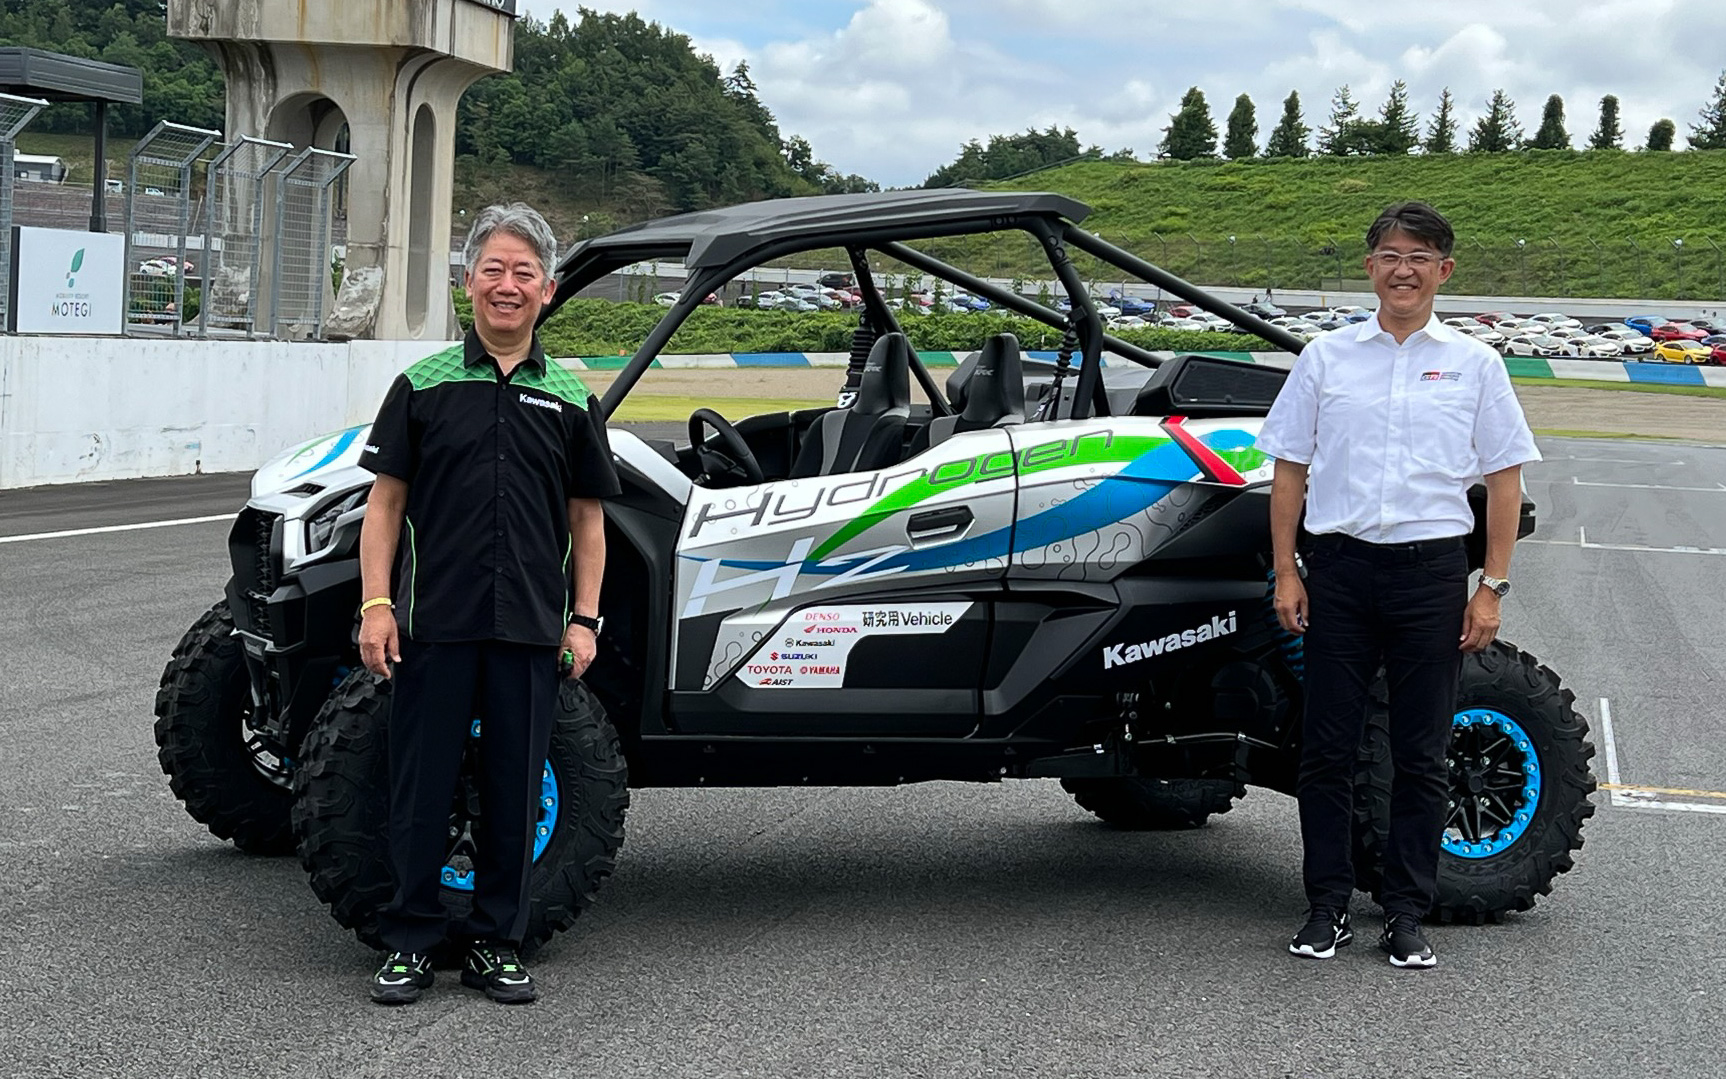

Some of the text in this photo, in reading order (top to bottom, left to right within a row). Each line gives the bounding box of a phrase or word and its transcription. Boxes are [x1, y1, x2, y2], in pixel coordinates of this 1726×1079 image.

[51, 302, 92, 317] MOTEGI
[519, 393, 562, 412] Kawasaki
[688, 428, 1114, 539] Hydrogen
[805, 612, 840, 621] DENSO
[796, 639, 835, 647] Kawasaki
[1103, 610, 1237, 670] Kawasaki
[747, 665, 793, 674] TOYOTA
[809, 666, 840, 674] YAMAHA
[771, 678, 794, 686] AIST
